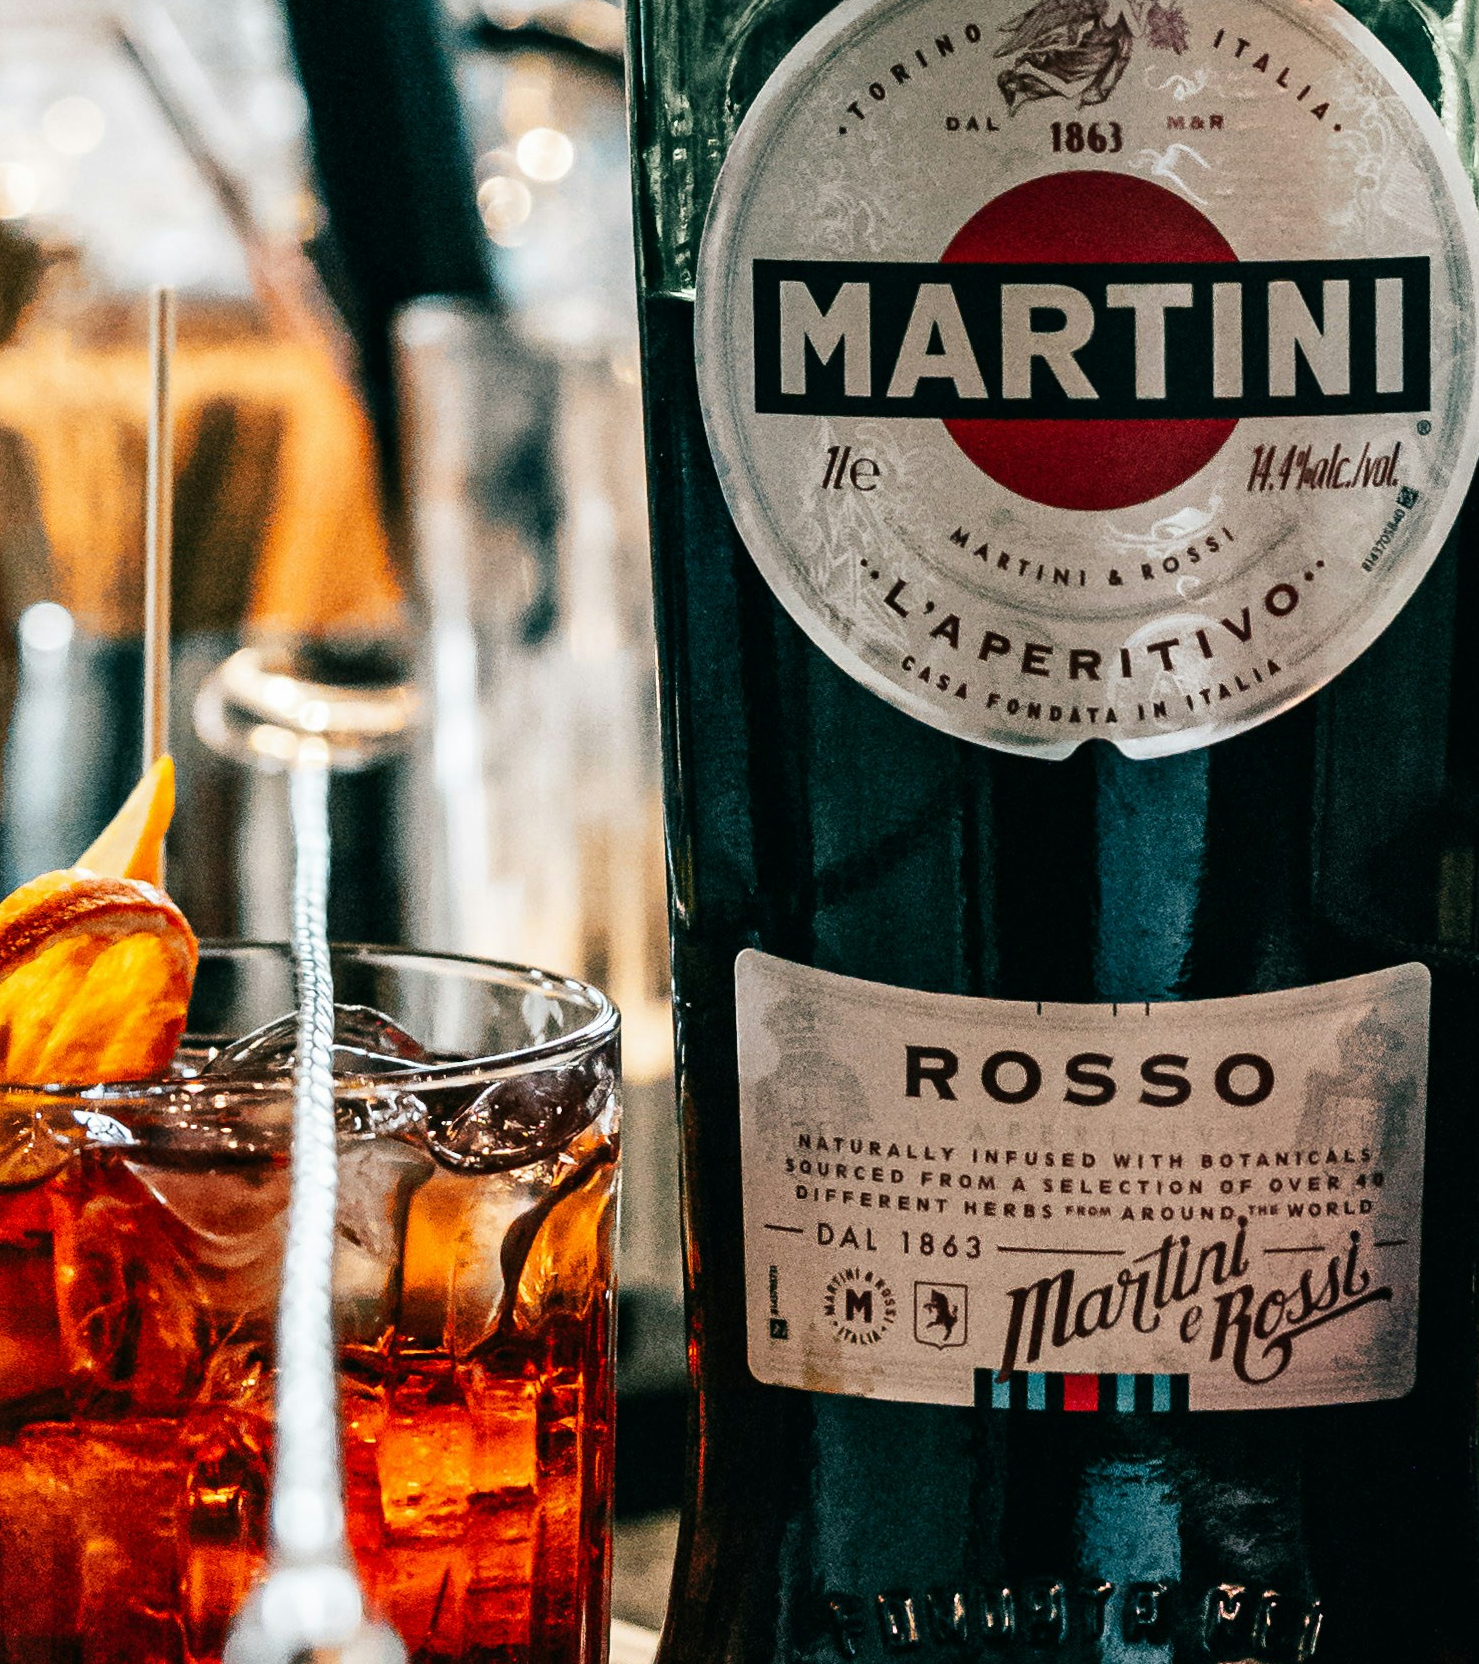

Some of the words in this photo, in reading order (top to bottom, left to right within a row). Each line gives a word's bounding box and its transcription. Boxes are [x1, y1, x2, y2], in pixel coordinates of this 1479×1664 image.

[847, 23, 981, 120] TORINO
[1212, 28, 1329, 121] ITALIA
[946, 115, 1000, 133] DAL
[1049, 120, 1123, 154] 1863
[778, 277, 1405, 402] MARTINI
[949, 525, 1086, 586] MARTINI
[1108, 569, 1123, 586] &
[1140, 526, 1235, 580] ROSSI
[883, 577, 1300, 681] L'APERITIVO
[900, 654, 969, 700] CASA
[984, 692, 1119, 724] FONDATA
[1137, 700, 1168, 721] IN
[1186, 658, 1282, 711] ITALIA
[904, 1043, 1276, 1108] ROSSO
[785, 1157, 905, 1184] SOURCED
[921, 1171, 996, 1191] FROM
[1011, 1176, 1026, 1192] A
[1042, 1177, 1203, 1195] SELECTION
[1219, 1178, 1253, 1194] OF
[1268, 1175, 1340, 1193] OVER
[1355, 1173, 1385, 1188] 40
[798, 1133, 955, 1162] NATURALLY
[972, 1148, 1097, 1168] INFUSED
[1113, 1152, 1184, 1169] WITH
[1200, 1147, 1373, 1169] BOTANICALS
[795, 1184, 949, 1213] DIFFERENT
[963, 1200, 1053, 1219] HERBS
[1064, 1205, 1112, 1217] FROM
[1121, 1205, 1234, 1221] AROUND
[1247, 1204, 1279, 1216] THE
[1286, 1199, 1373, 1218] WORLD
[816, 1222, 878, 1252] DAL
[901, 1230, 983, 1259] 1863
[824, 1265, 860, 1316] MARTINI
[874, 1277, 897, 1324] ROSSI
[845, 1288, 873, 1324] M
[994, 1215, 1250, 1384] Martini
[1178, 1305, 1204, 1345] e
[1208, 1230, 1393, 1386] Rossi
[837, 1326, 882, 1346] ITALIA
